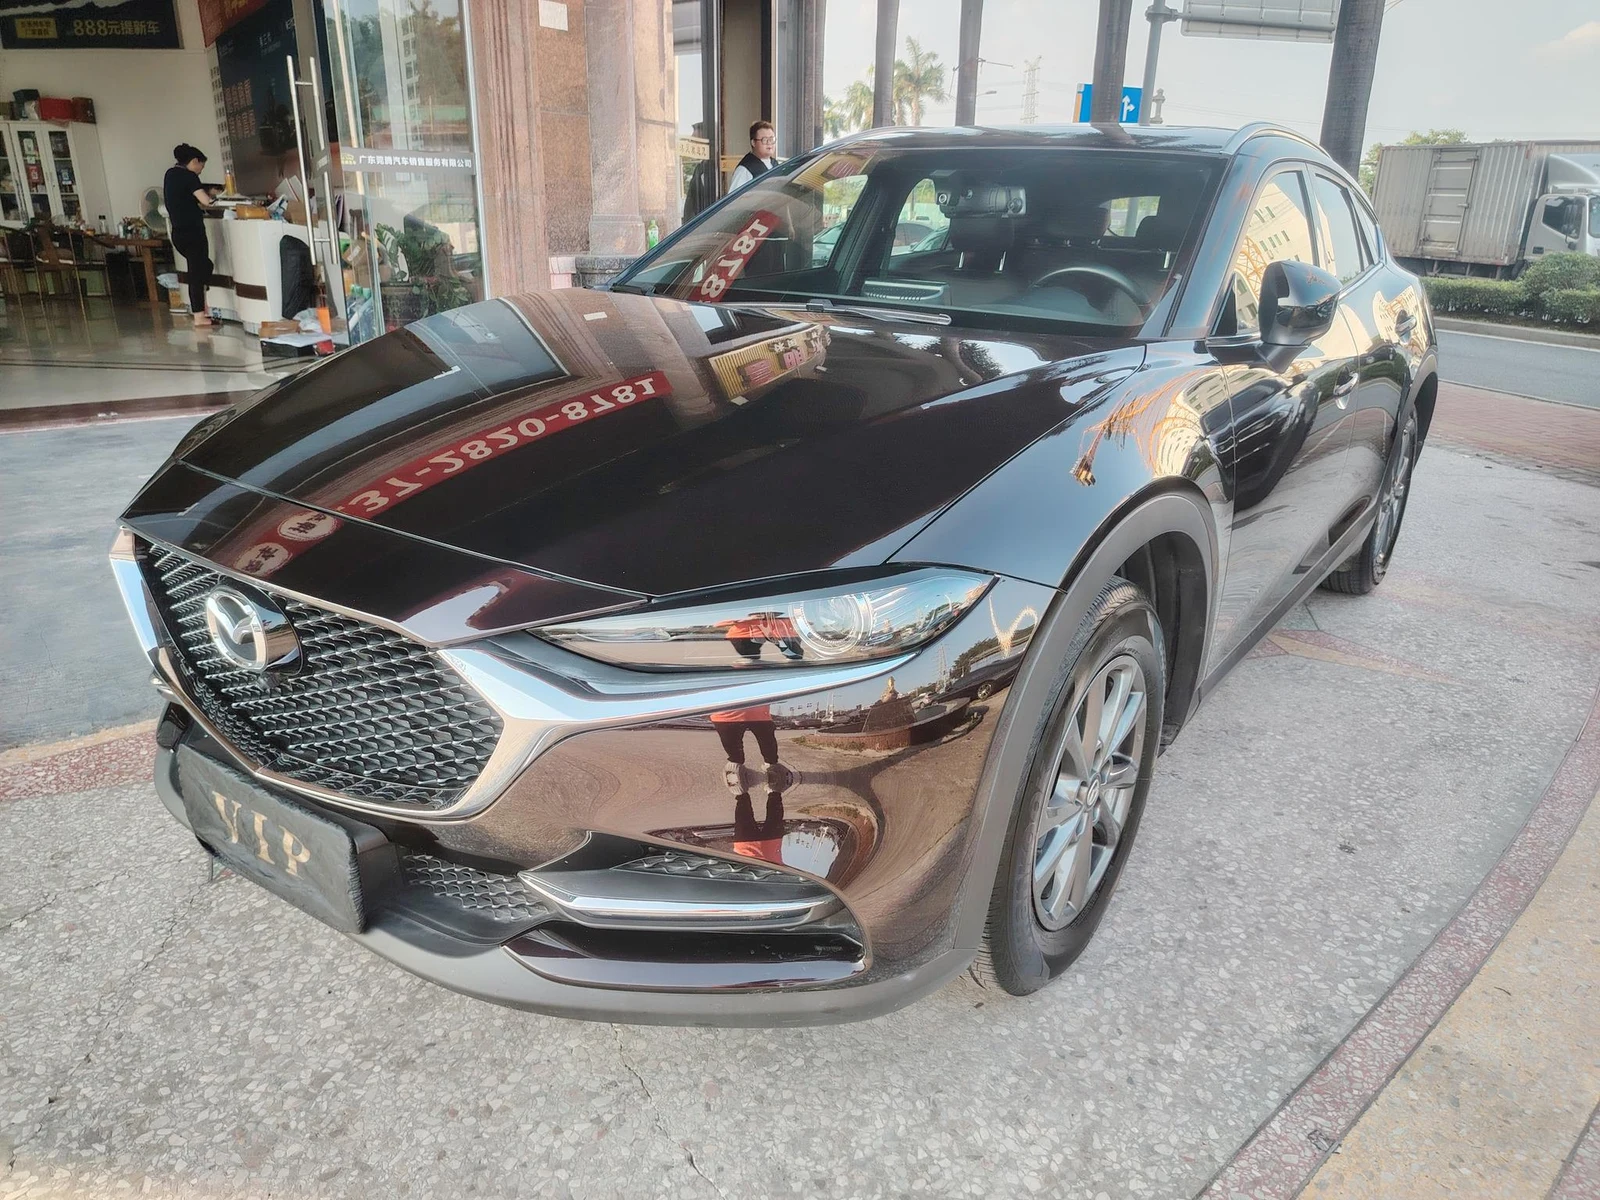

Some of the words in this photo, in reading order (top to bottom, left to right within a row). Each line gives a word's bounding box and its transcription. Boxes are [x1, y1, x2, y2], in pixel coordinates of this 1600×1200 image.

[73, 19, 160, 36] 888元提新车
[212, 791, 310, 880] VIP
